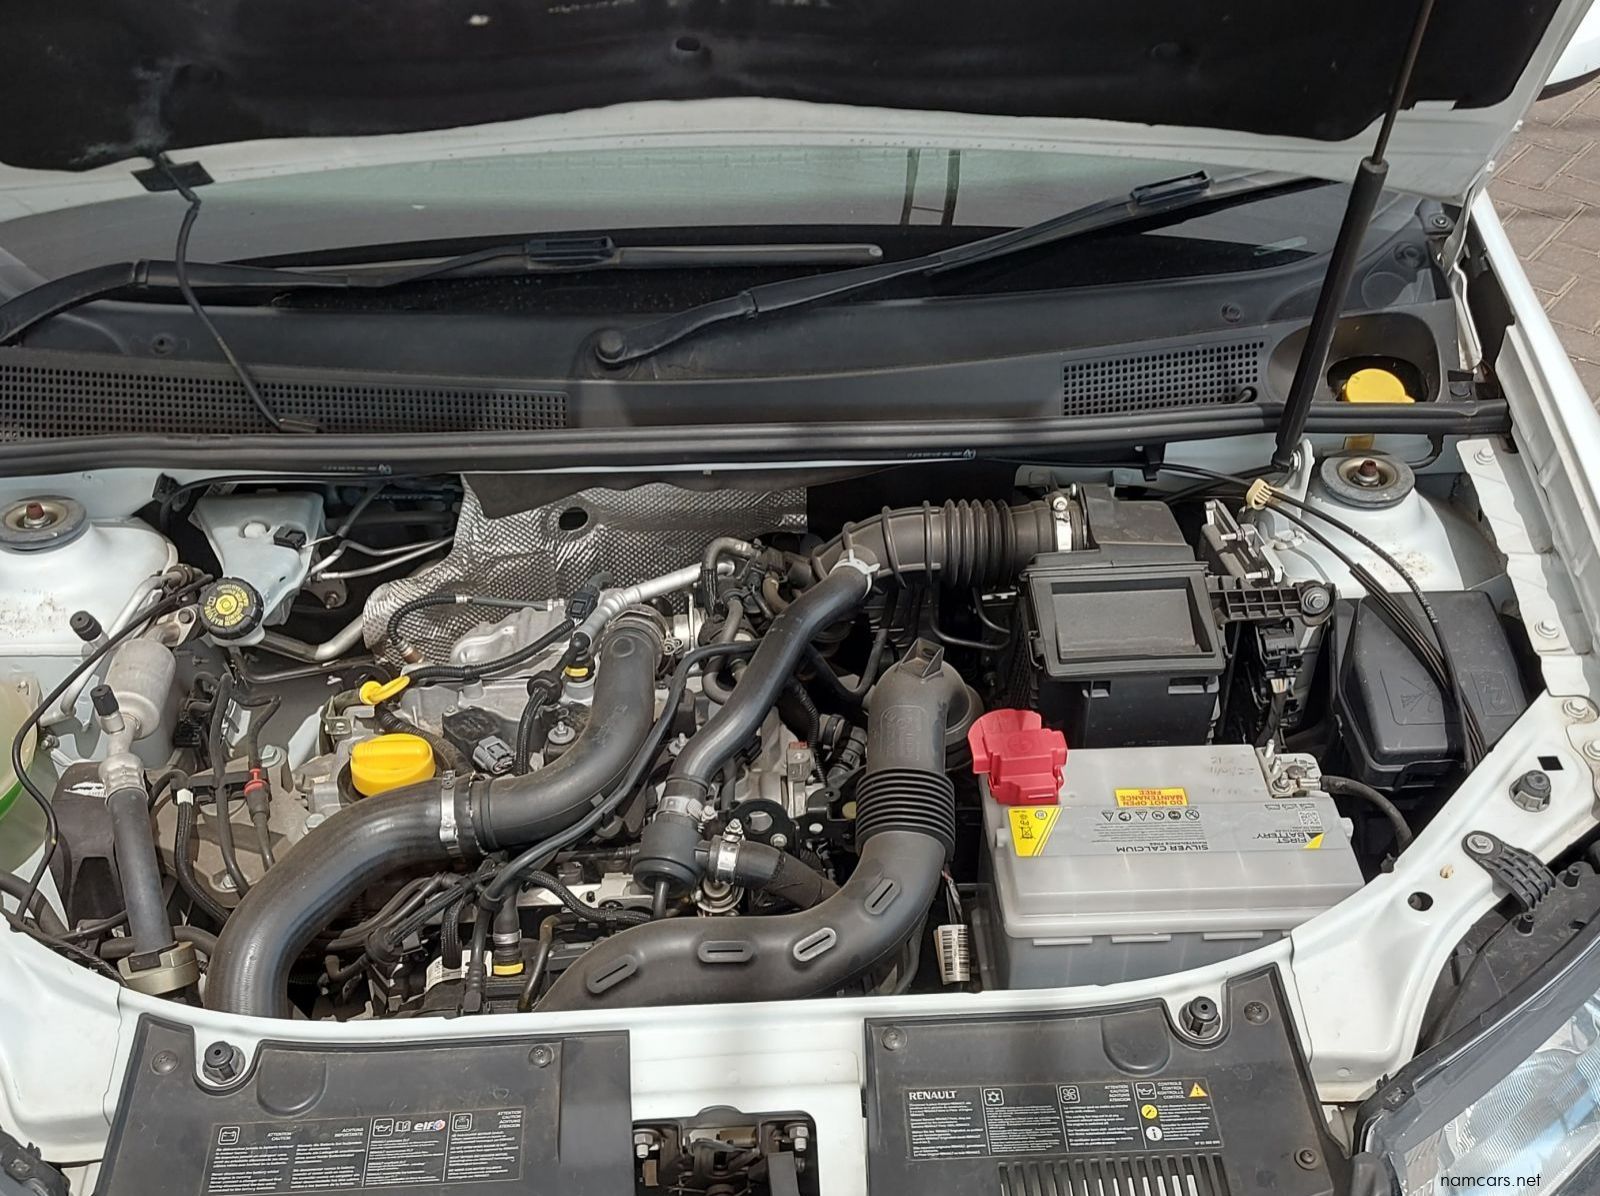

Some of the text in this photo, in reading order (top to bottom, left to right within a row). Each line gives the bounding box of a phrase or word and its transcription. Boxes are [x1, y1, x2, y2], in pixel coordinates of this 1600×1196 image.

[1116, 845, 1167, 853] CALCIUM
[908, 1090, 957, 1100] RENAULT
[413, 1120, 434, 1131] elf
